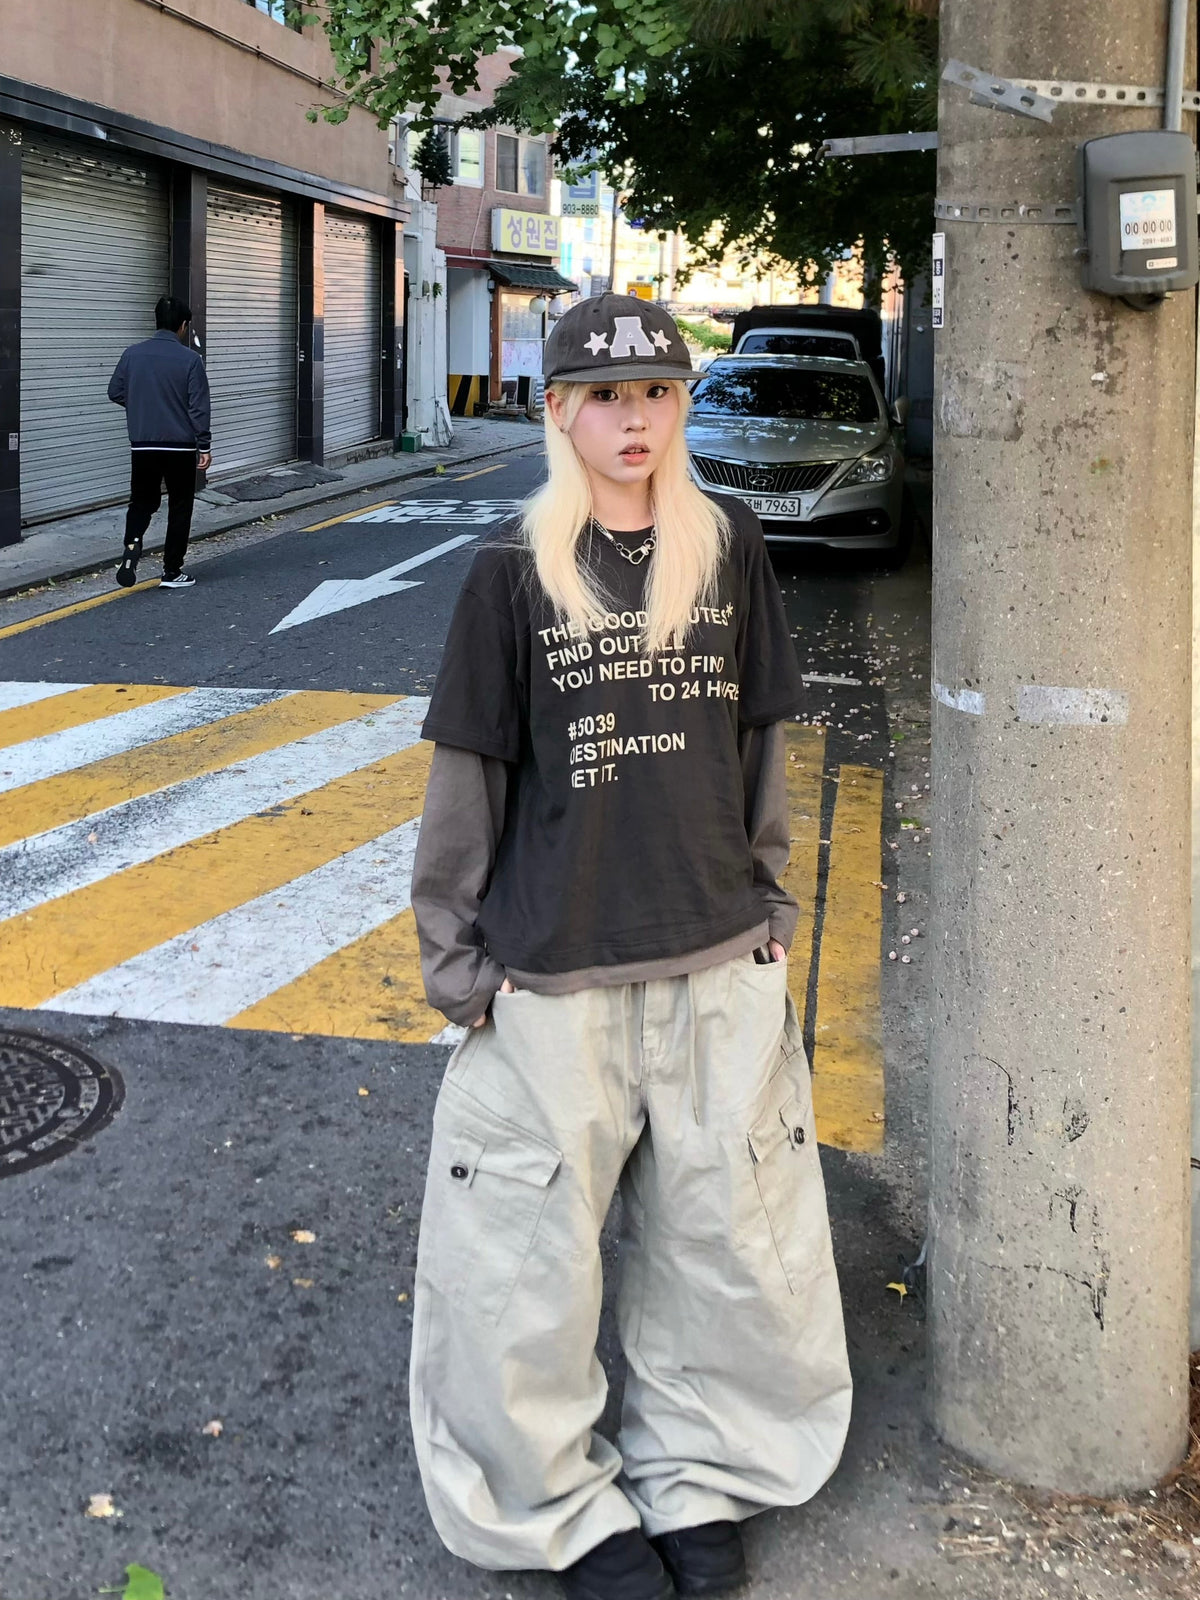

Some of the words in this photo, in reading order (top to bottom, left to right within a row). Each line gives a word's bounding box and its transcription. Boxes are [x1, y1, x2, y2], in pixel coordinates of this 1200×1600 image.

[562, 203, 600, 216] 903-8860
[507, 215, 559, 251] 성원집
[610, 316, 656, 359] A
[765, 500, 796, 513] 7963
[538, 620, 582, 647] THE
[546, 642, 593, 671] FIND
[599, 635, 641, 656] OUT
[551, 665, 593, 693] YOU
[598, 659, 653, 682] NEED
[658, 656, 686, 676] TO
[648, 682, 676, 702] TO
[681, 680, 701, 700] 24
[567, 712, 616, 741] #5039
